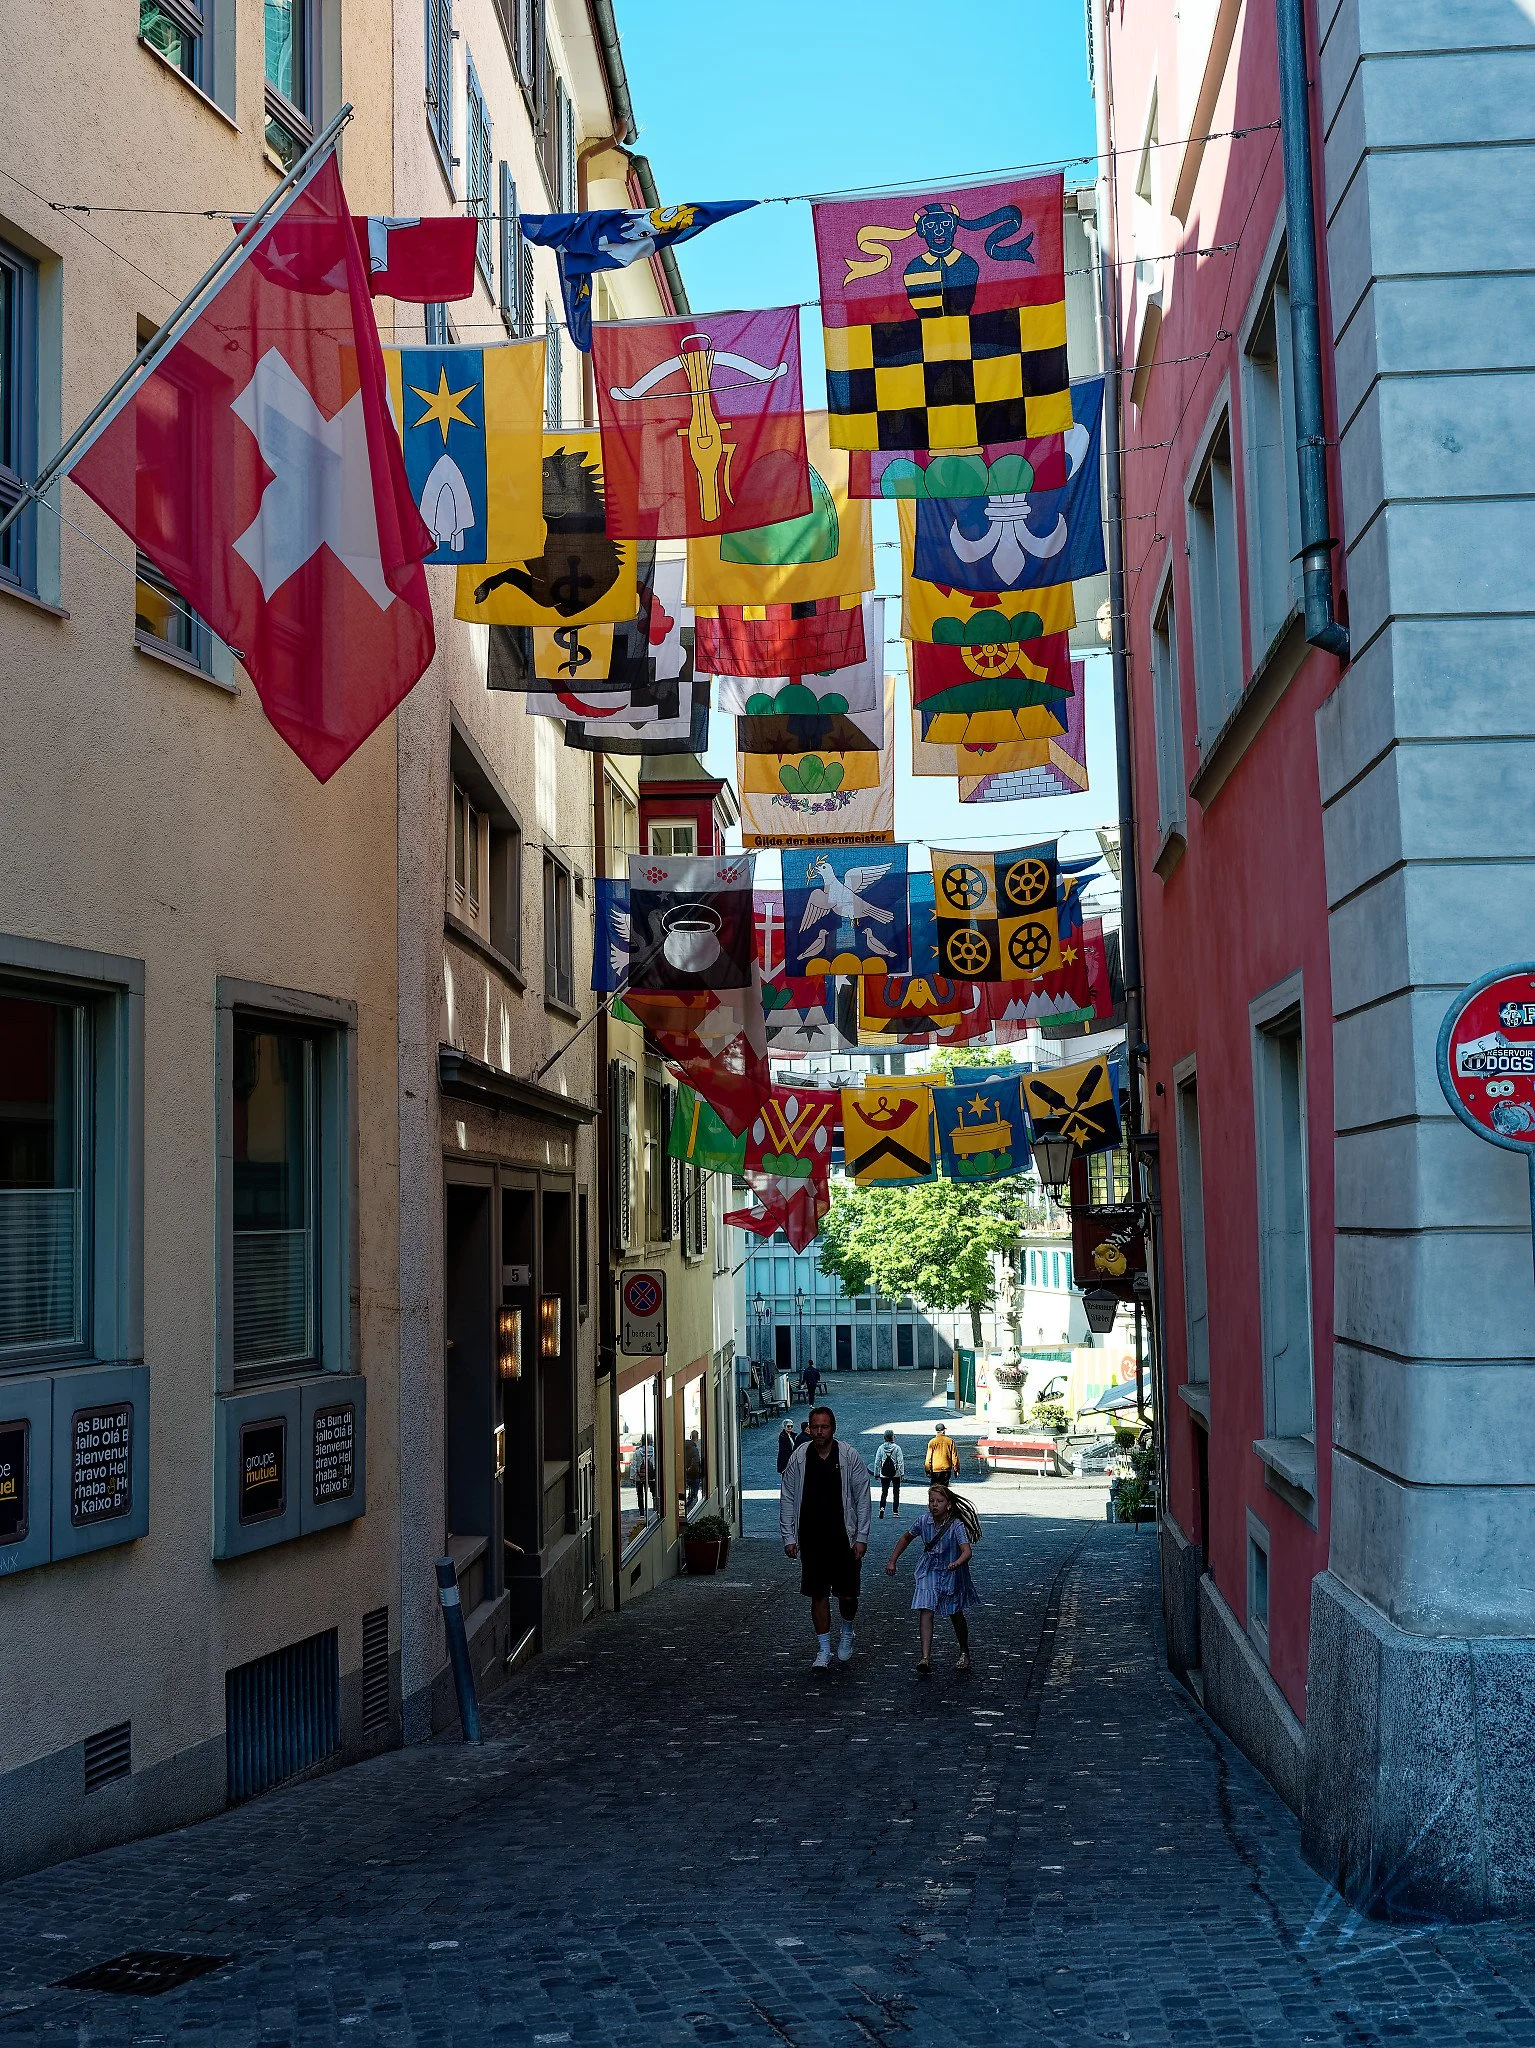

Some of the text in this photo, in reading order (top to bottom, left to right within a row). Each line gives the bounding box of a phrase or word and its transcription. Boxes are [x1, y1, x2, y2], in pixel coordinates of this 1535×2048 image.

[754, 832, 887, 847] Gilde der Nelkenmeister
[1486, 1049, 1533, 1058] RESERVOIR
[1486, 1056, 1534, 1071] DOGS
[511, 1268, 520, 1283] 5
[77, 1412, 127, 1434] as Bun di
[327, 1415, 342, 1427] Bun
[343, 1411, 351, 1424] di
[102, 1428, 120, 1445] Olá
[334, 1424, 346, 1439] Olá
[246, 1453, 275, 1471] groupe
[315, 1455, 338, 1470] dravo
[75, 1459, 126, 1483] dravo Hel
[246, 1464, 277, 1483] mutuel
[315, 1468, 337, 1483] rhaba
[74, 1481, 106, 1500] rhaba
[320, 1480, 341, 1495] Kaixo
[81, 1496, 112, 1514] Kaixo
